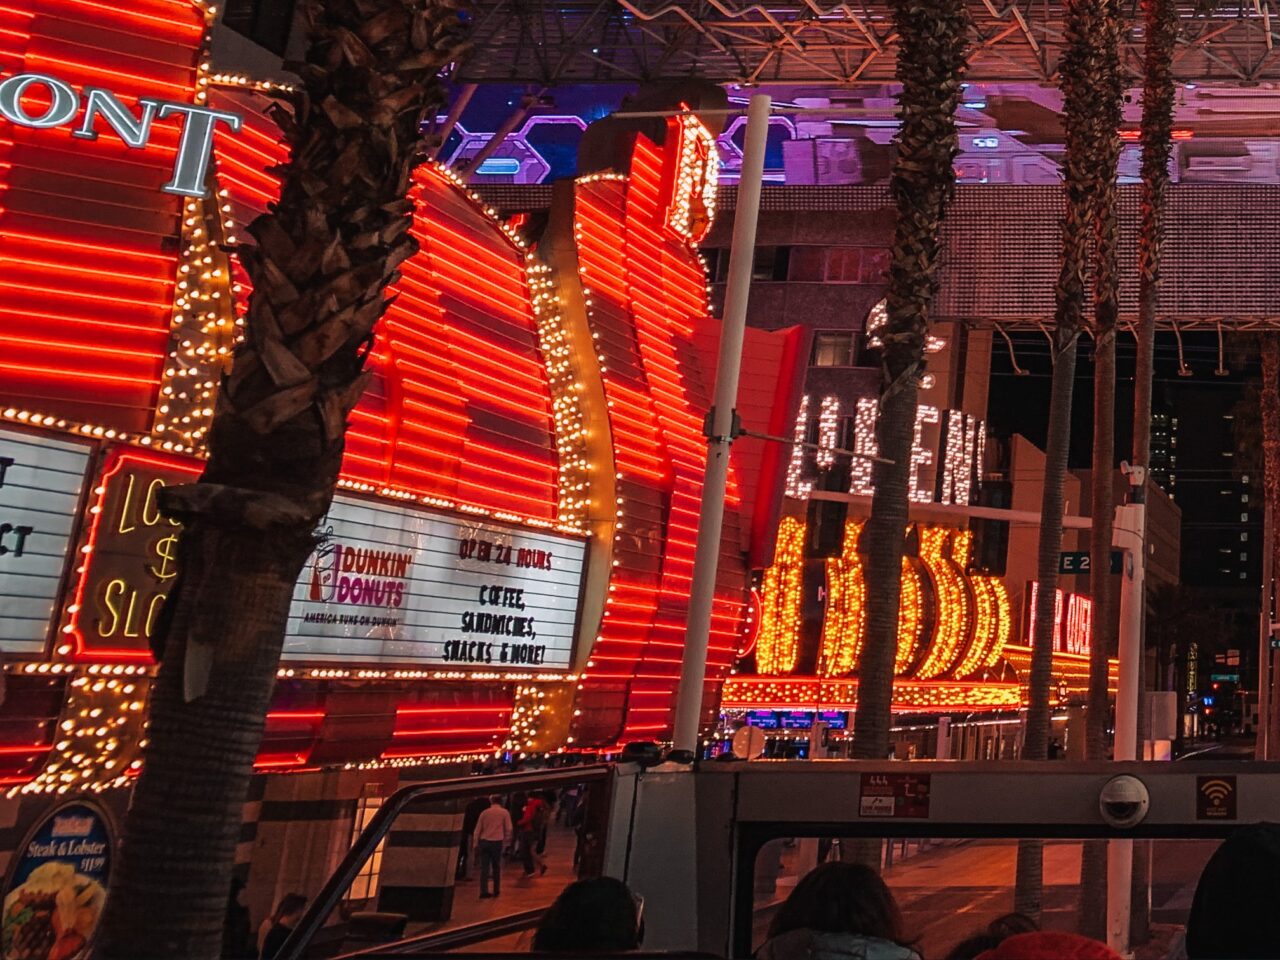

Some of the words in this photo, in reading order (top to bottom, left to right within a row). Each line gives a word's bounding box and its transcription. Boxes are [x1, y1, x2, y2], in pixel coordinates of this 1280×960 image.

[0, 73, 242, 198] ONT
[343, 546, 413, 578] DUNKIN'
[459, 538, 493, 562] OPEN
[495, 544, 512, 566] 24
[516, 547, 553, 571] HOURS
[1063, 556, 1074, 569] E
[337, 576, 405, 608] DONUTS
[479, 584, 525, 611] COFFEE,
[304, 612, 337, 624] AMERICA
[340, 614, 358, 626] RUNS
[359, 615, 370, 626] ON
[461, 611, 537, 640] SANDWICHES,
[442, 639, 493, 664] SNACKS
[510, 643, 546, 665] MORE!
[28, 841, 57, 858] Steak
[57, 842, 67, 856] &
[67, 839, 106, 856] Lobster
